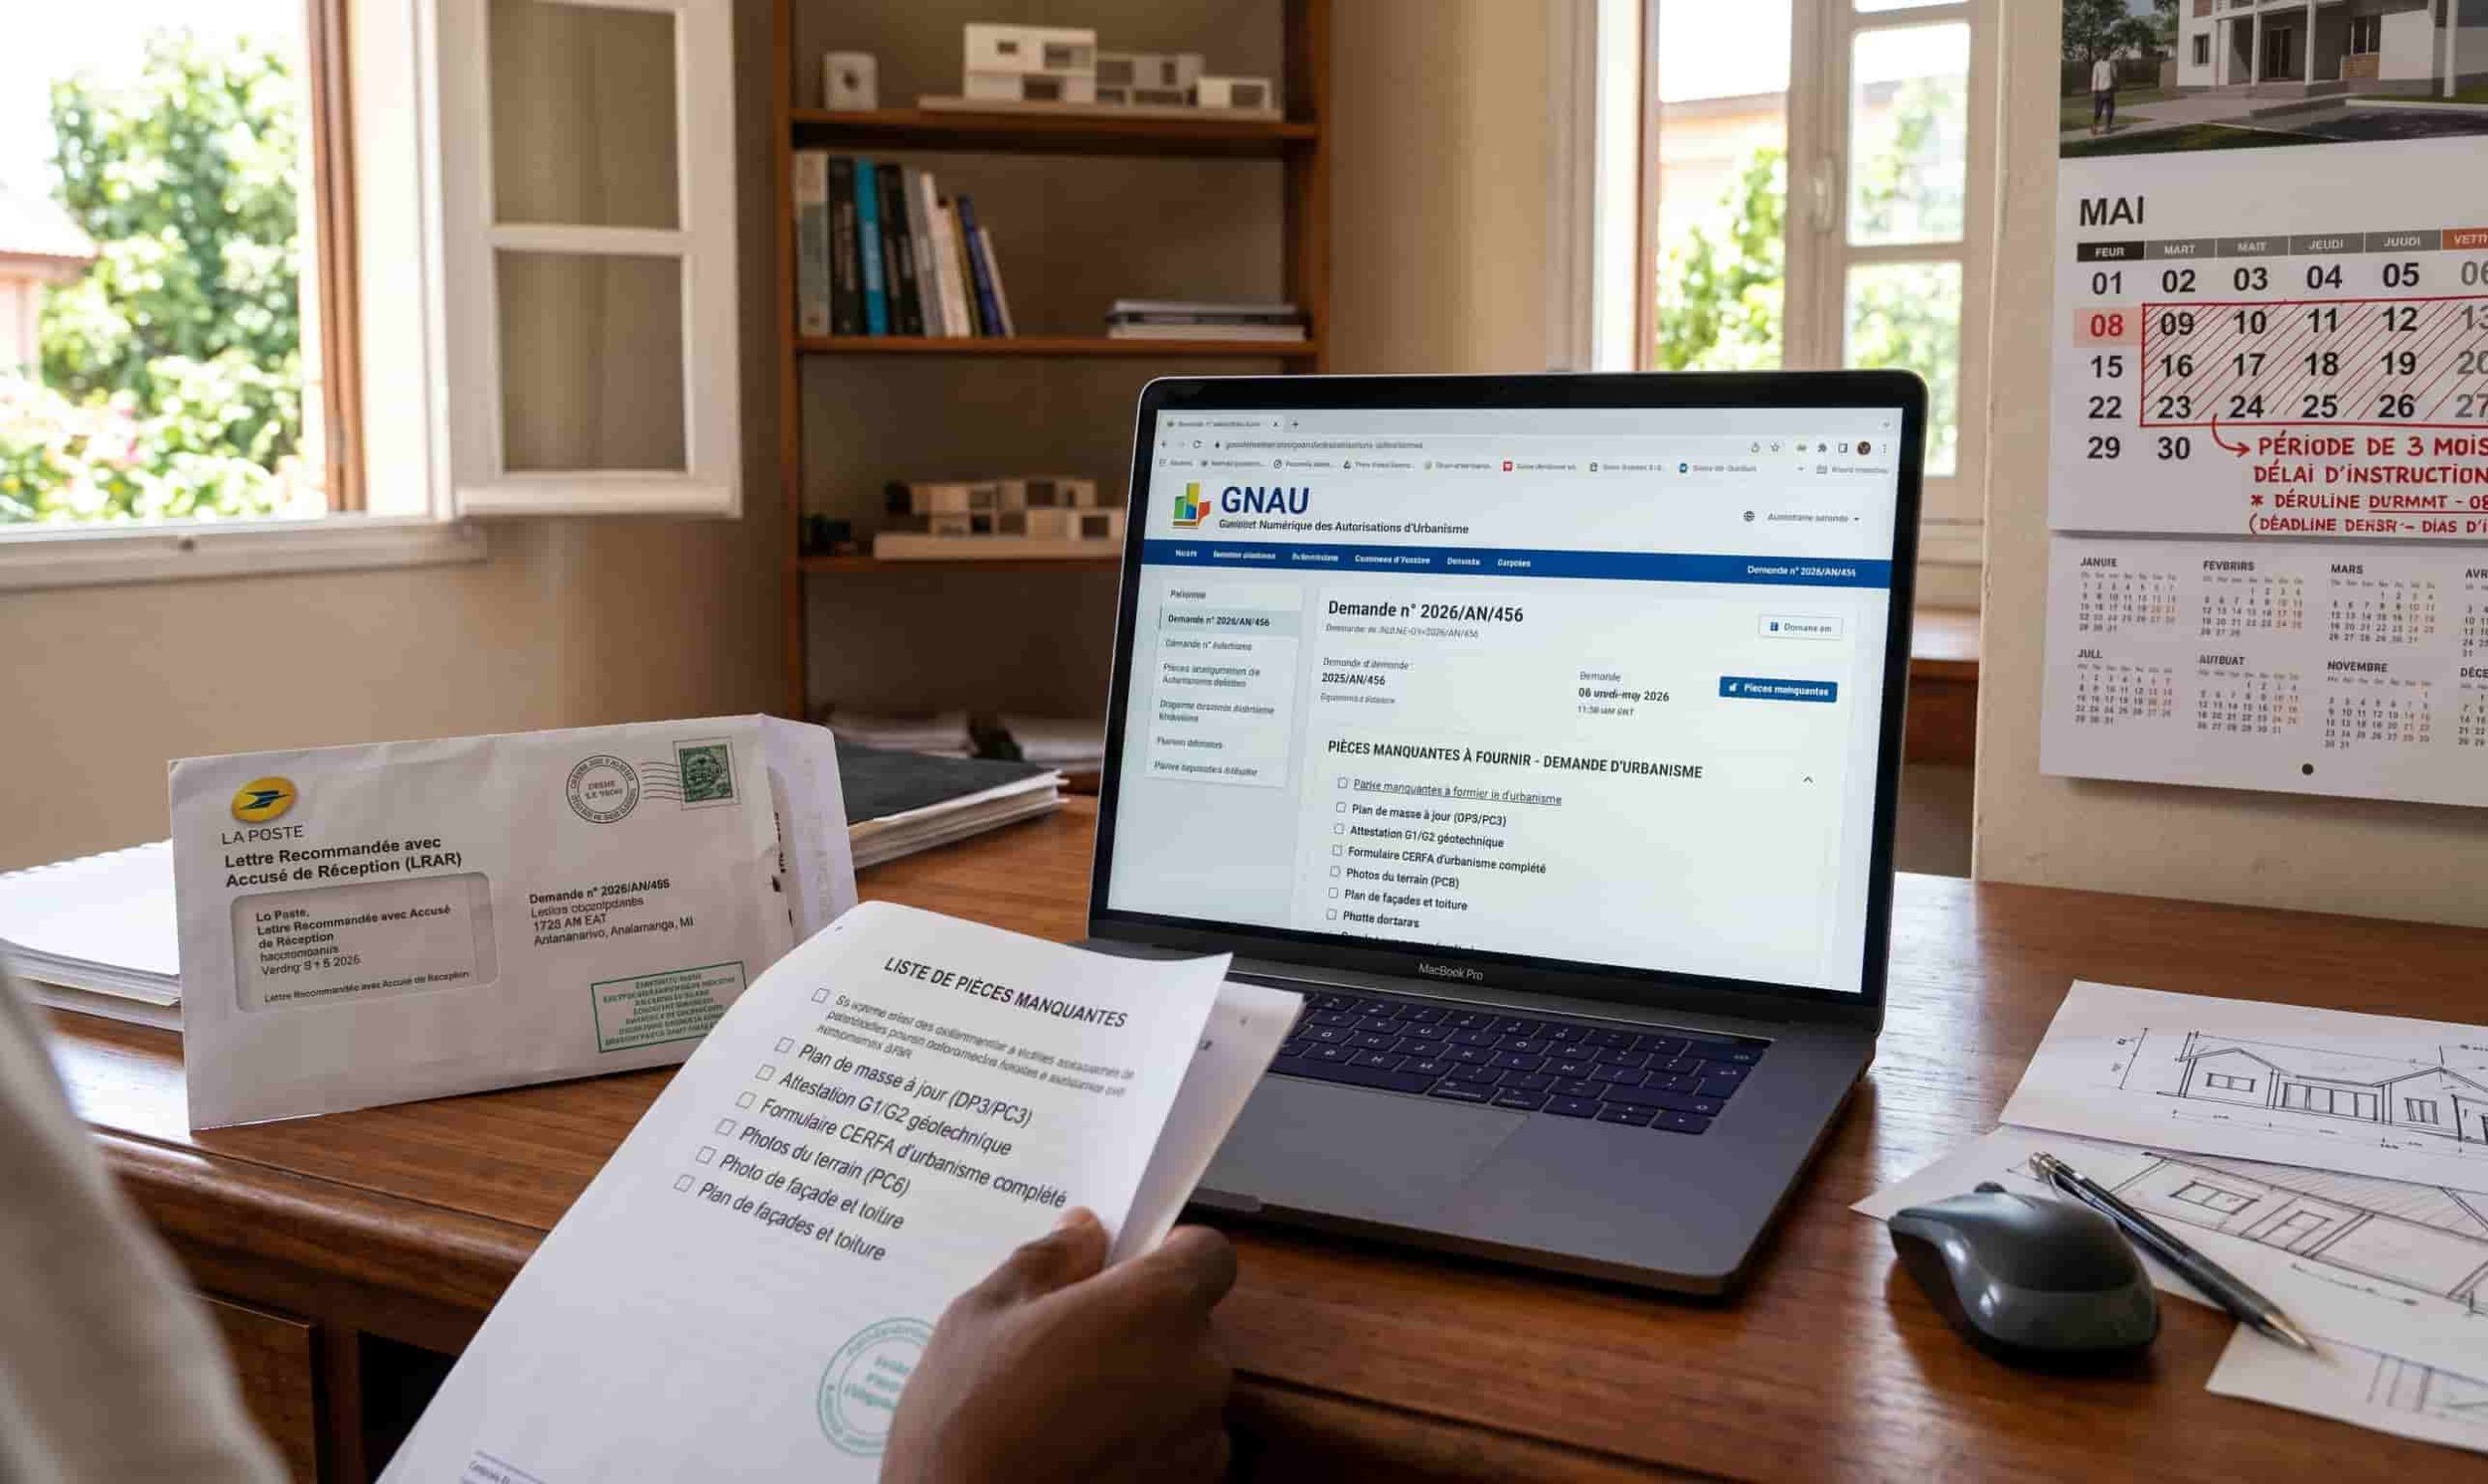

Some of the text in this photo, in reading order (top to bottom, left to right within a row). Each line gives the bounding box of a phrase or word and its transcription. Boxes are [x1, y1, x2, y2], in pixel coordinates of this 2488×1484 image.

[2080, 196, 2144, 225] MAI
[2163, 244, 2195, 255] MART
[2308, 239, 2343, 251] JEUDI
[2092, 271, 2122, 295] 01
[2161, 269, 2195, 293] 02
[2233, 267, 2268, 292] 03
[2306, 264, 2343, 290] 04
[2383, 262, 2420, 287] 05
[2090, 314, 2125, 337] 08
[2160, 312, 2194, 336] 09
[2233, 310, 2267, 334] 10
[2307, 308, 2338, 332] 11
[2382, 306, 2418, 332] 12
[2091, 355, 2124, 379] 15
[2160, 354, 2194, 378] 16
[2232, 353, 2266, 377] 17
[2304, 352, 2339, 376] 18
[2381, 351, 2416, 375] 19
[2089, 396, 2123, 420] 22
[2158, 396, 2192, 420] 23
[2229, 395, 2264, 419] 24
[2301, 394, 2338, 419] 25
[2378, 394, 2415, 418] 26
[2088, 436, 2191, 461] 29 30
[2367, 437, 2396, 456] DE
[2406, 436, 2424, 457] 3
[1221, 486, 1309, 515] GNAU
[1315, 521, 1331, 531] des
[1334, 521, 1401, 534] Autorisations
[1404, 522, 1469, 535] d'Urbanisme
[2331, 564, 2364, 574] MARS
[1329, 600, 1524, 623] Demande n° 2026/AN/456
[2327, 661, 2388, 673] NOVEMBRE
[1643, 691, 1671, 703] 2026
[1328, 739, 1703, 778] PIÈCES MANQUANTES À FOURNIR DEMANDE D'URBANISME
[1352, 804, 1373, 815] Plan
[1375, 806, 1388, 816] de
[1390, 809, 1422, 820] masse
[1431, 811, 1451, 823] jour
[222, 825, 305, 845] LA POSTE
[1350, 826, 1504, 848] Attestation G1/G2 géotechnique
[225, 838, 441, 868] Lettre Recommandée avec
[1348, 846, 1400, 861] Formulaire
[1402, 851, 1434, 864] CERFA
[1436, 855, 1498, 870] d'urbanisme
[225, 852, 462, 888] Accusé de Réception (LRAR)
[1346, 867, 1380, 880] Photos
[1382, 871, 1395, 882] du
[530, 889, 584, 905] Demande
[1344, 888, 1469, 912] Plan de façades et toiture
[584, 913, 606, 925] EAT
[1417, 962, 1484, 982] MacBook Pro
[883, 956, 931, 981] LISTE
[930, 969, 955, 987] DE
[1014, 991, 1129, 1028] MANQUANTES
[797, 1043, 833, 1067] Plan
[833, 1055, 853, 1074] de
[853, 1064, 904, 1088] masse
[914, 1080, 949, 1102] jour
[948, 1089, 1033, 1129] (DP3/PC3)
[778, 1071, 1013, 1156] Attestation G1/G2 géotechnique
[739, 1125, 912, 1199] Photos du terrain (PC6)
[760, 1097, 1068, 1209] Formulaire CERFA d'urbanisme complété
[718, 1153, 905, 1230] Photo de façade et toiture
[697, 1182, 886, 1261] Plan de façades et toiture
